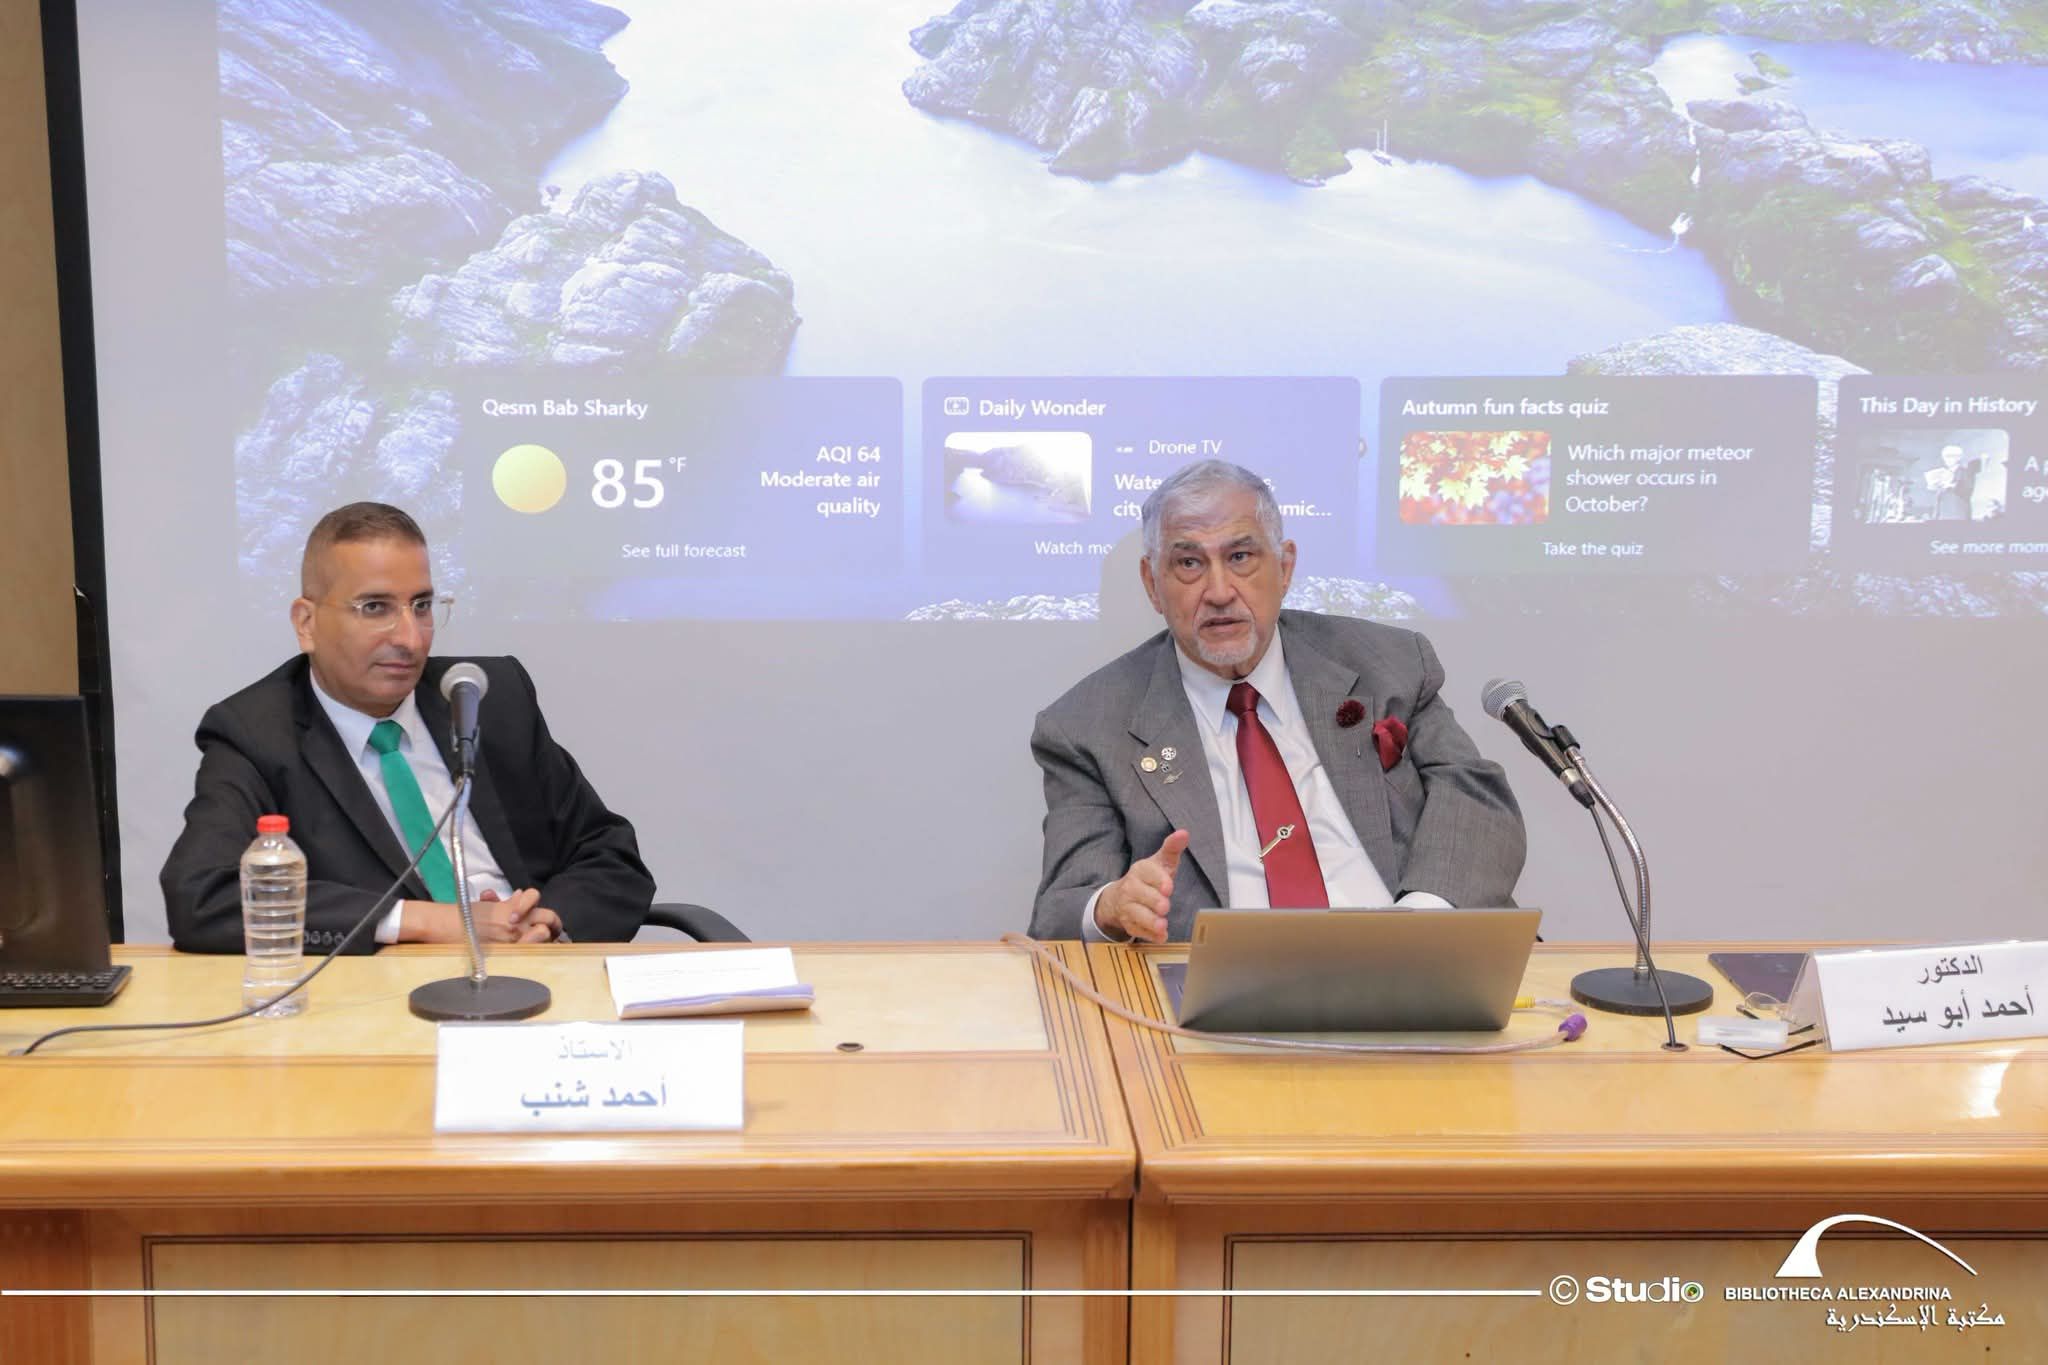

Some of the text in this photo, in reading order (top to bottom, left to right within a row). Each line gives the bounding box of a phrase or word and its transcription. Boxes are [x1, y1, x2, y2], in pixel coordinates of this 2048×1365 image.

[482, 398, 649, 420] Qesm Bab Sharky
[979, 398, 1107, 420] Daily Wonder
[1402, 398, 1610, 419] Autumn fun facts quiz
[1859, 397, 2038, 417] This Day in History
[816, 446, 881, 465] AQI 64
[1149, 439, 1197, 454] Drone
[1201, 439, 1223, 454] TV
[1567, 443, 1754, 465] Which major meteor
[2024, 455, 2039, 471] A
[591, 458, 665, 509] 85
[761, 470, 881, 488] Moderate air
[1114, 473, 1162, 490] Wate
[1566, 468, 1717, 486] shower occurs in
[816, 496, 881, 518] quality
[1565, 494, 1649, 514] October?
[622, 542, 746, 559] See full forecast
[1034, 541, 1083, 555] Watch
[1543, 541, 1645, 559] Take the quiz
[1930, 540, 1960, 555] See
[1962, 542, 2006, 554] more
[1917, 954, 1983, 984] الدكتور
[1882, 985, 2035, 1032] أحمد أبو سيد
[520, 1079, 590, 1117] شنب
